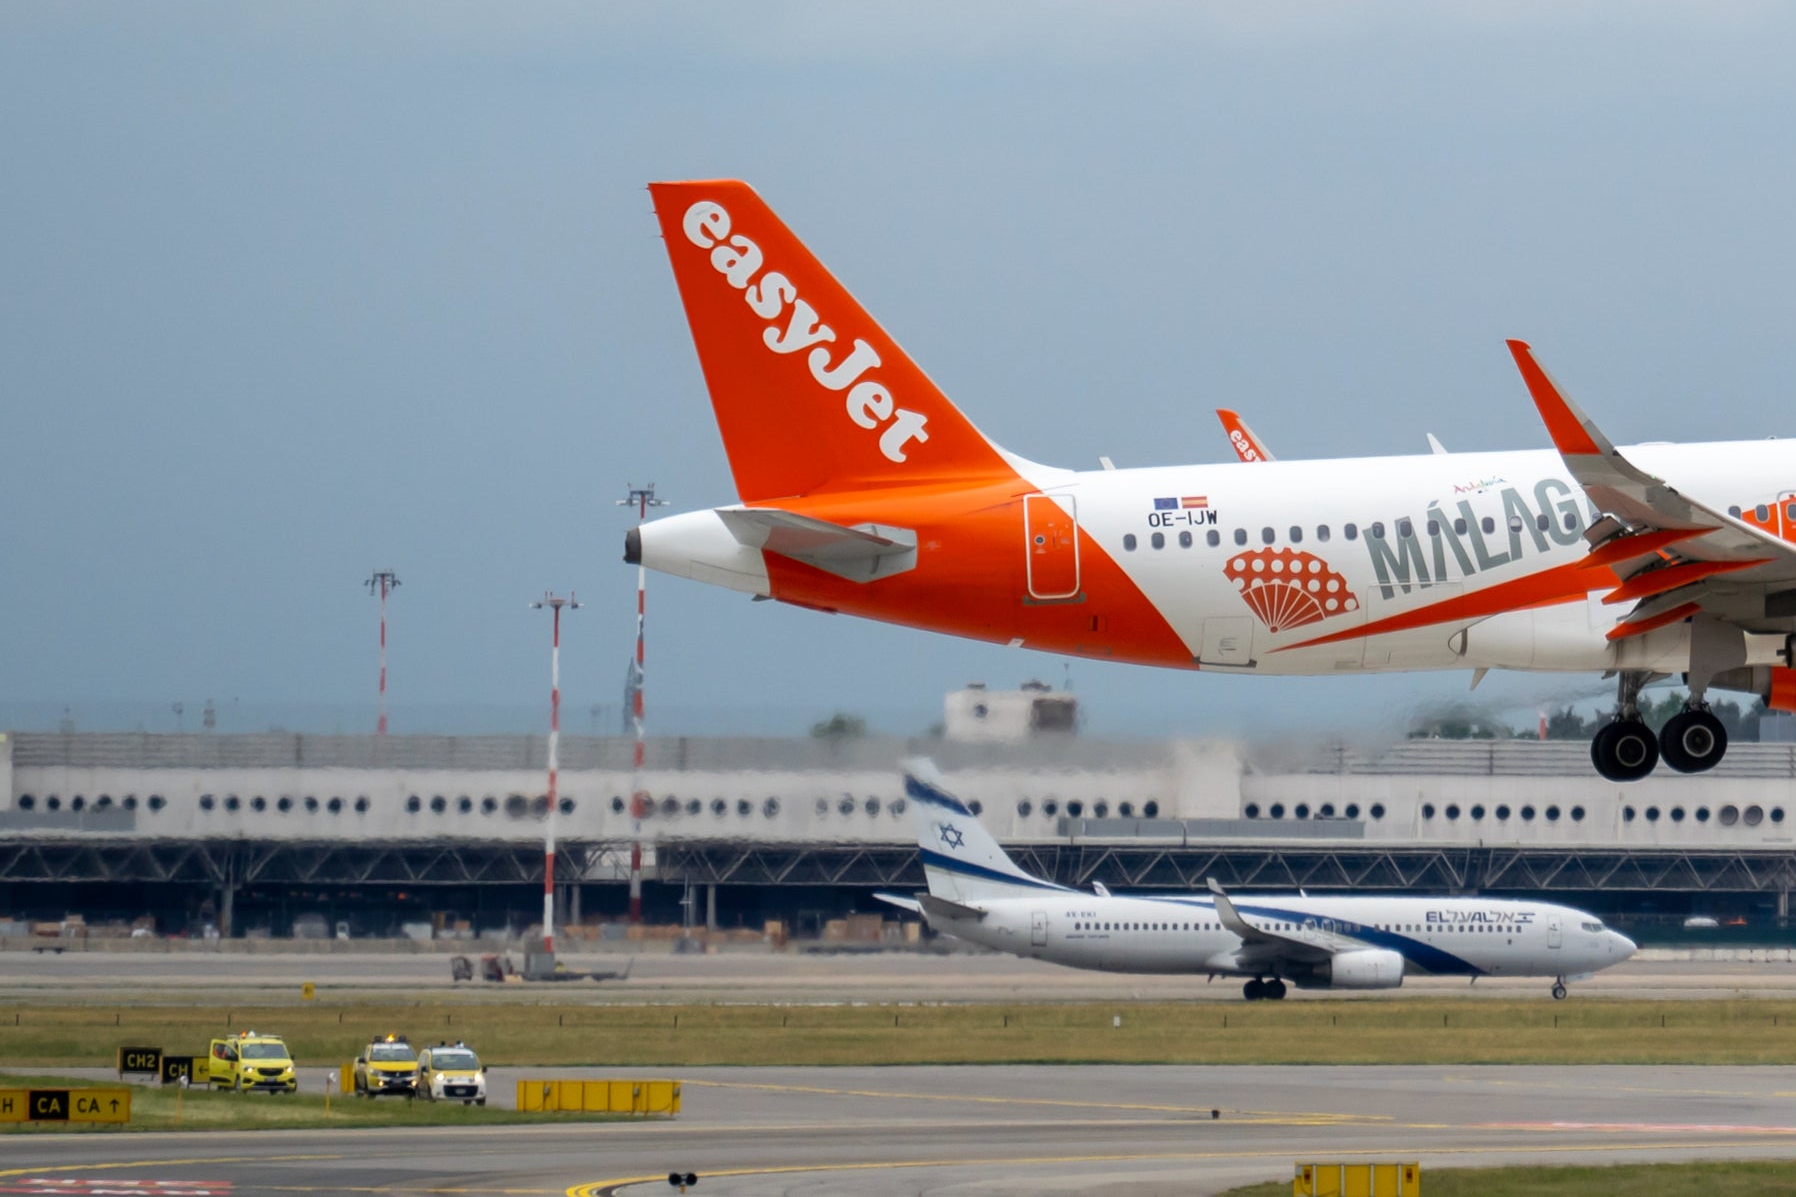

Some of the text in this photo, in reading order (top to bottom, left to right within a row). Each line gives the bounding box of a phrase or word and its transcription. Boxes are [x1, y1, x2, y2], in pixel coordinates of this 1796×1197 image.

[682, 200, 930, 464] easyJet
[1148, 510, 1218, 528] OE-IJW
[1363, 478, 1604, 601] MÁLAG
[127, 1053, 156, 1068] CH2
[168, 1063, 188, 1077] CH
[37, 1097, 61, 1113] CA
[77, 1097, 101, 1113] CA
